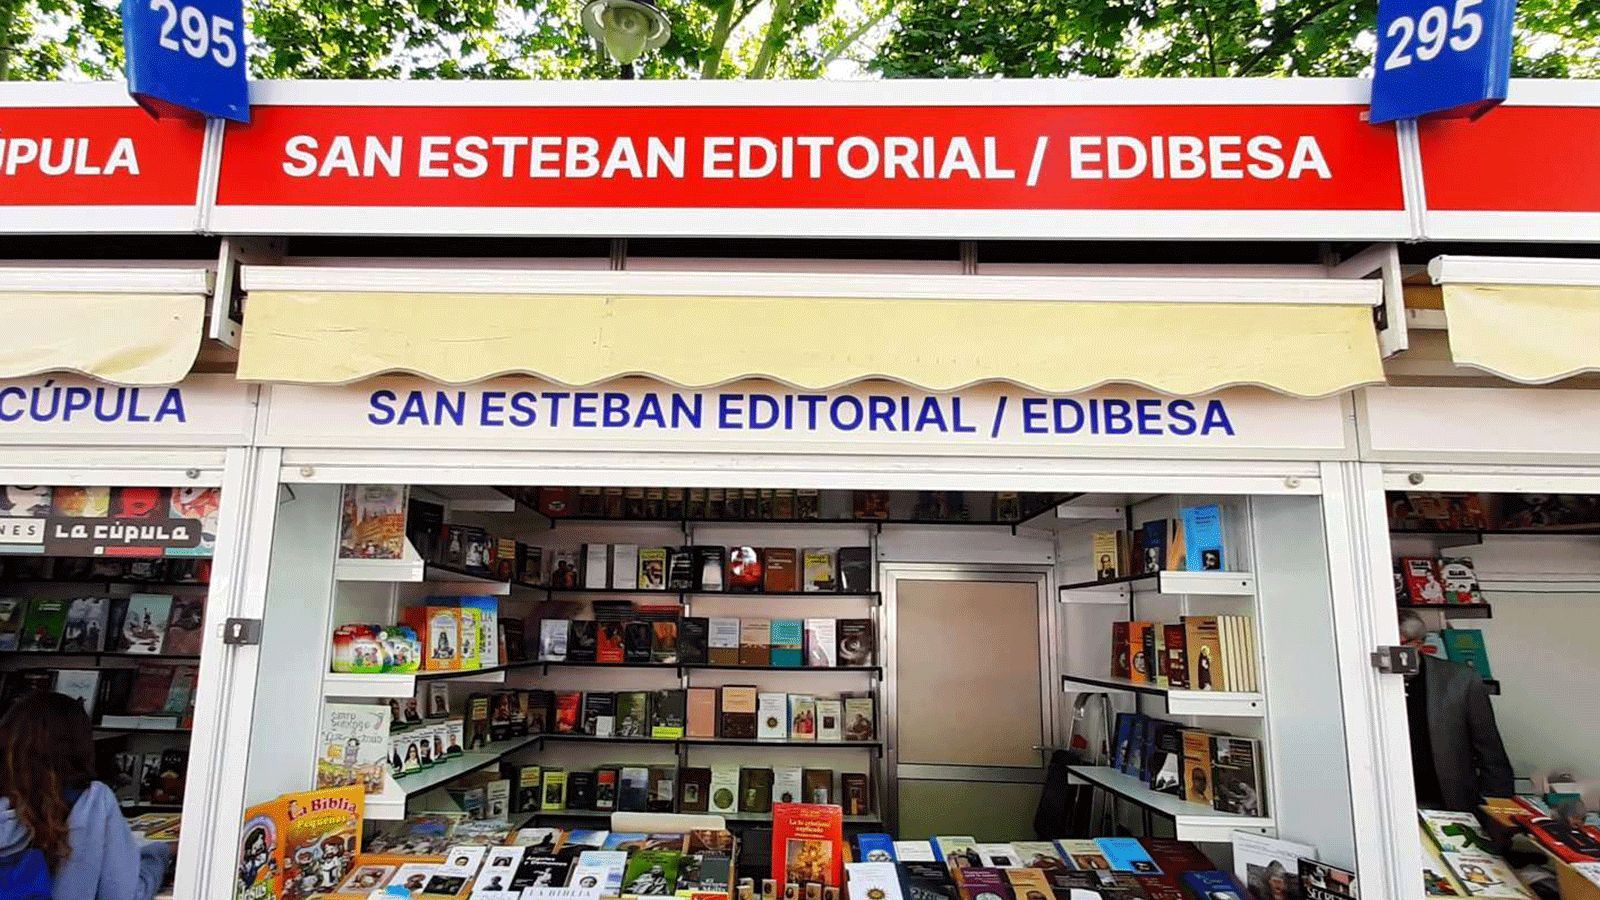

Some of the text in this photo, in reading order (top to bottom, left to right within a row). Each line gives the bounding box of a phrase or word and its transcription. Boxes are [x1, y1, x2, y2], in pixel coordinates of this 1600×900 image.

[150, 0, 237, 67] 295
[1384, 0, 1483, 71] 295
[0, 137, 140, 176] PULA
[282, 135, 1332, 187] SAN ESTEBAN EDITORIAL / EDIBESA
[0, 379, 186, 423] CÚPULA
[368, 391, 1235, 438] SAN ESTEBAN EDITORIAL / EDIBESA
